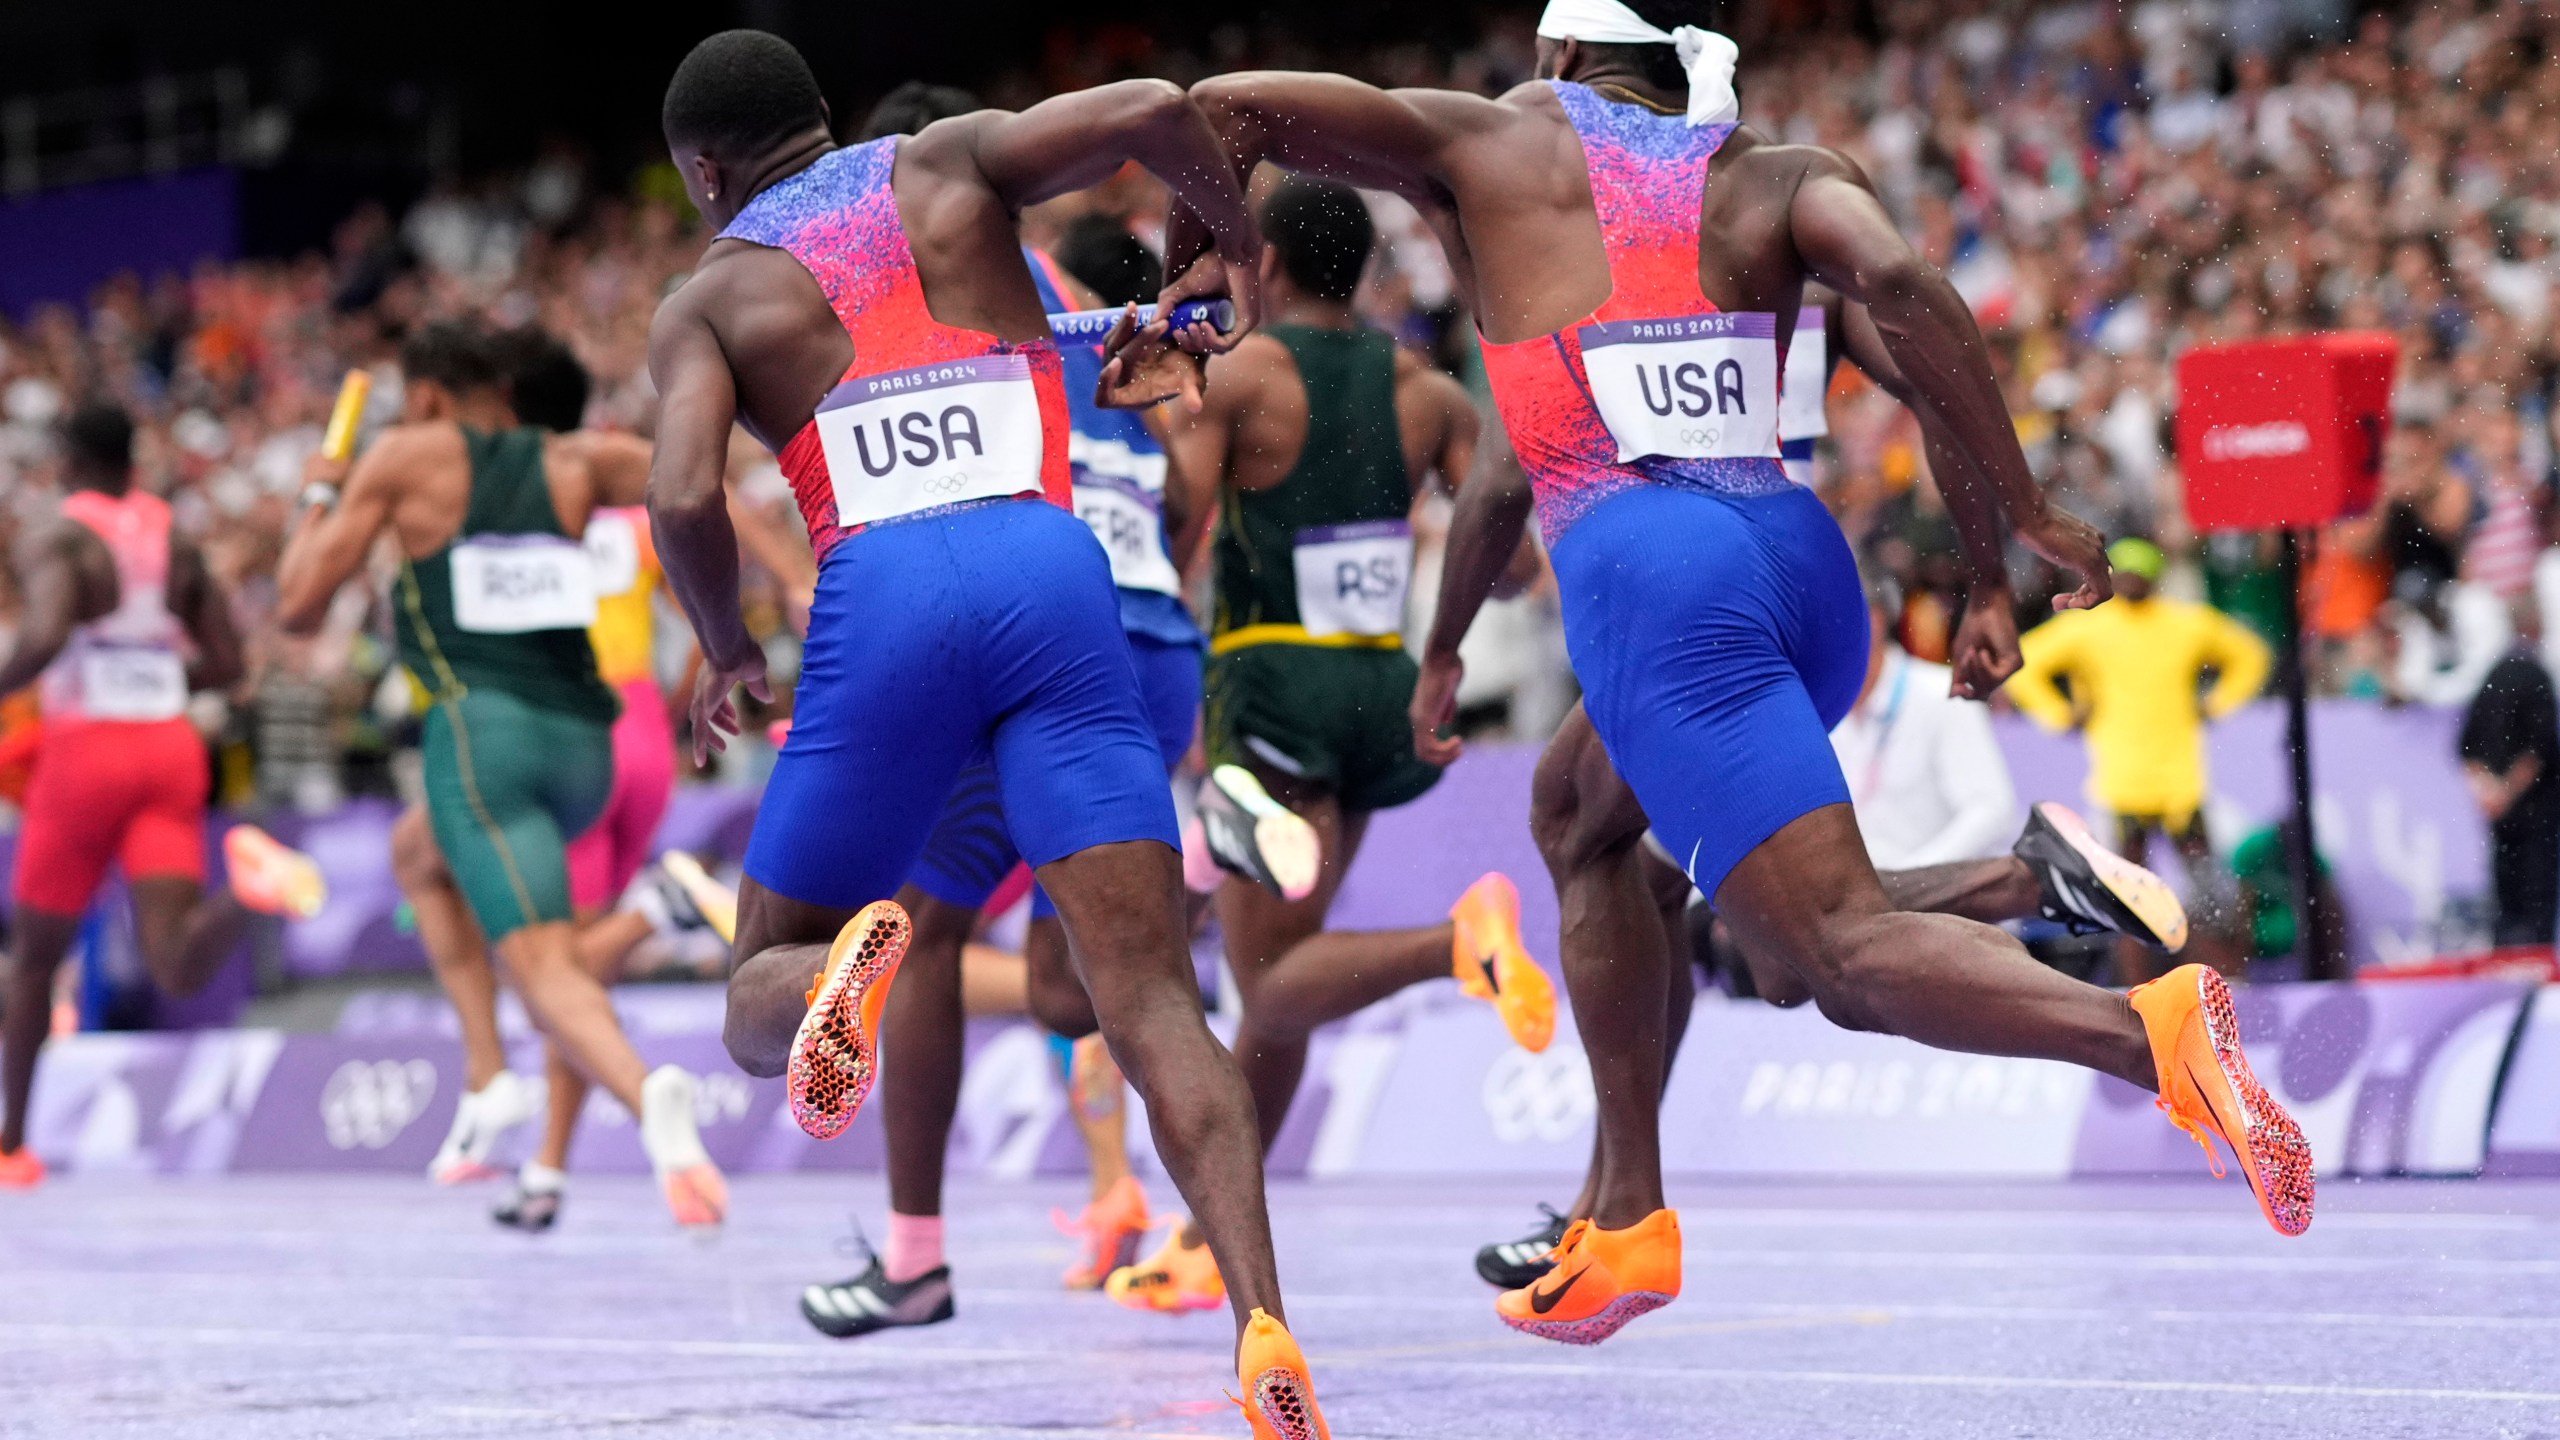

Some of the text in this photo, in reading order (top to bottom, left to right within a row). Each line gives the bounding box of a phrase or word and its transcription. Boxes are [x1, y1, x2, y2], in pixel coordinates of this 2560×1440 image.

[1056, 316, 1105, 336] 2024
[1632, 316, 1735, 337] PARIS 2024
[868, 365, 977, 394] PARIS 2024
[1635, 358, 1748, 418] USA
[852, 404, 984, 478] USA
[1336, 555, 1398, 602] RS
[1740, 1060, 1914, 1118] PARIS
